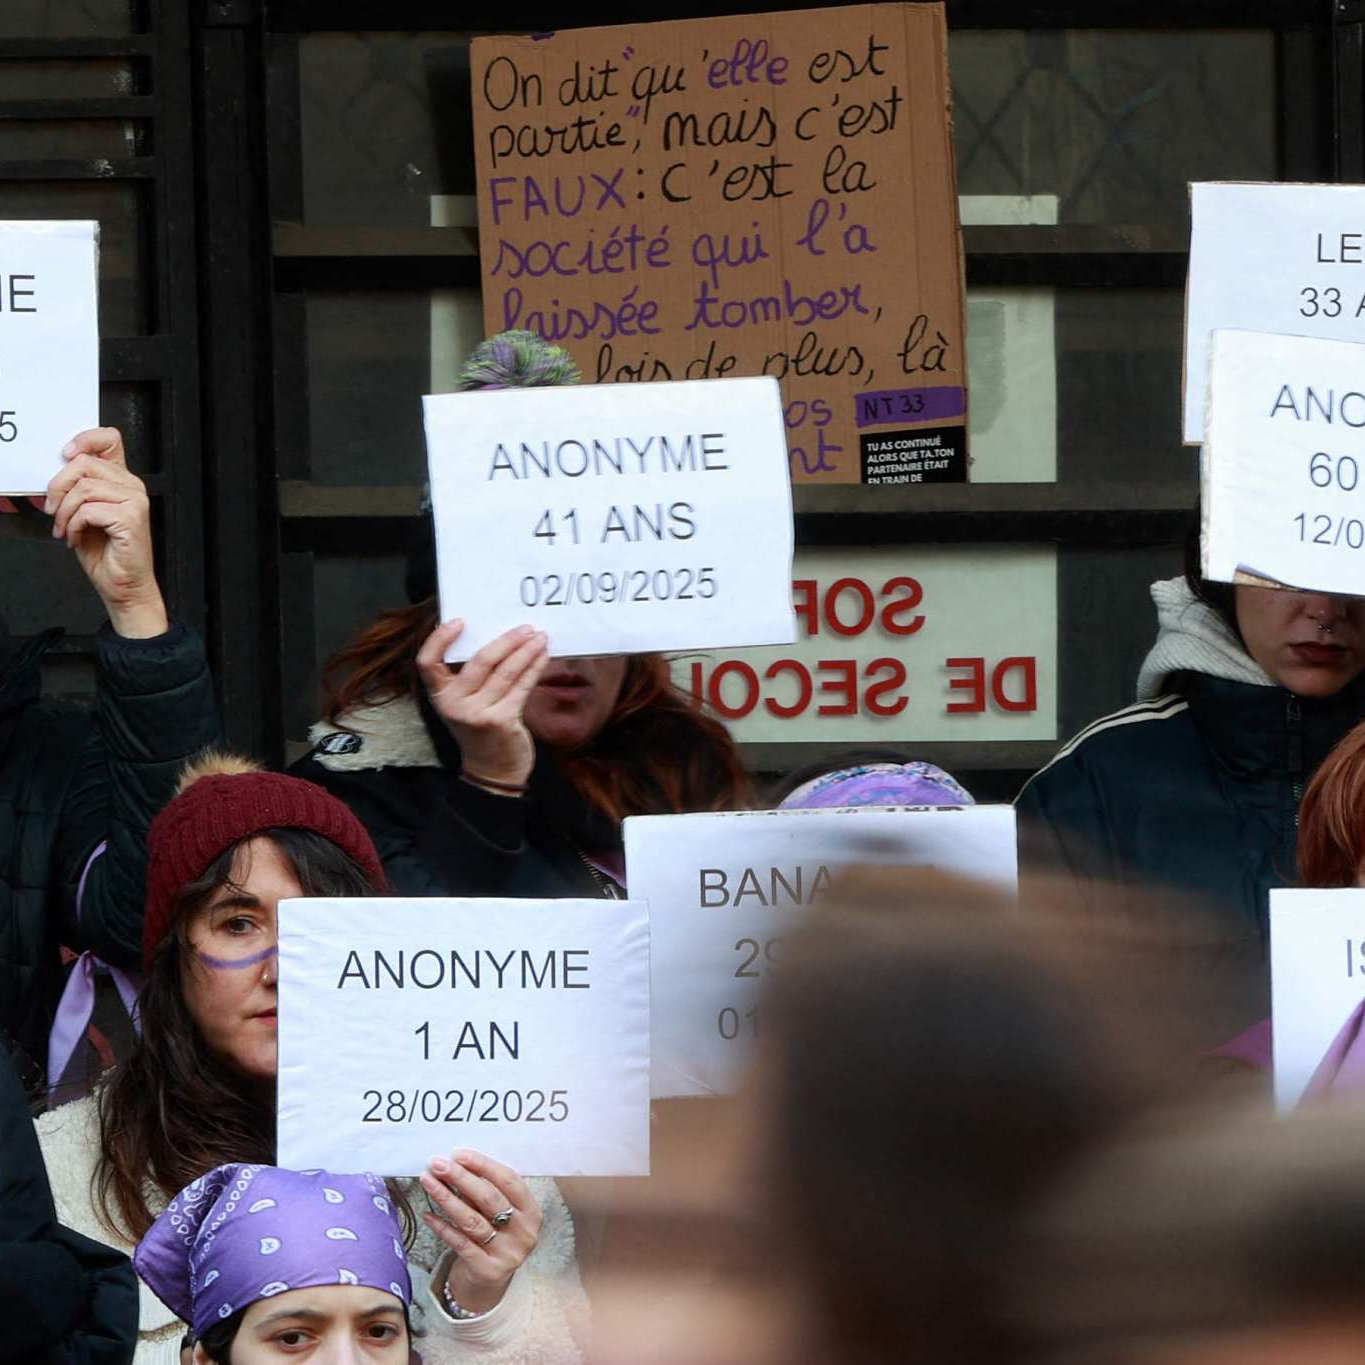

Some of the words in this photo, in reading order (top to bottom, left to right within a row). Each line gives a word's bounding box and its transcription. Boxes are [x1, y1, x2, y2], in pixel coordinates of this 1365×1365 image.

[484, 56, 542, 111] On
[558, 59, 621, 106] dit
[808, 35, 890, 85] est
[663, 98, 777, 150] mais
[823, 145, 876, 193] la
[491, 224, 670, 277] société
[691, 221, 769, 289] qui
[796, 199, 878, 255] l'a
[503, 287, 661, 341] laissée
[1300, 287, 1342, 317] 33
[897, 315, 950, 374] là
[488, 433, 730, 480] ANONYME
[867, 443, 879, 452] TU
[880, 442, 893, 451] AS
[867, 453, 898, 463] ALORS
[899, 450, 918, 462] QUE
[867, 462, 923, 474] PARTENAIRE
[911, 474, 923, 482] DE
[1309, 452, 1358, 491] 60
[532, 508, 579, 545] 41
[600, 502, 696, 543] ANS
[520, 567, 717, 607] 02/09/2025
[699, 864, 838, 908] BANA
[337, 949, 590, 989] ANONYME
[415, 1021, 429, 1060] 1
[452, 1021, 519, 1060] AN
[362, 1089, 569, 1123] 28/02/2025
